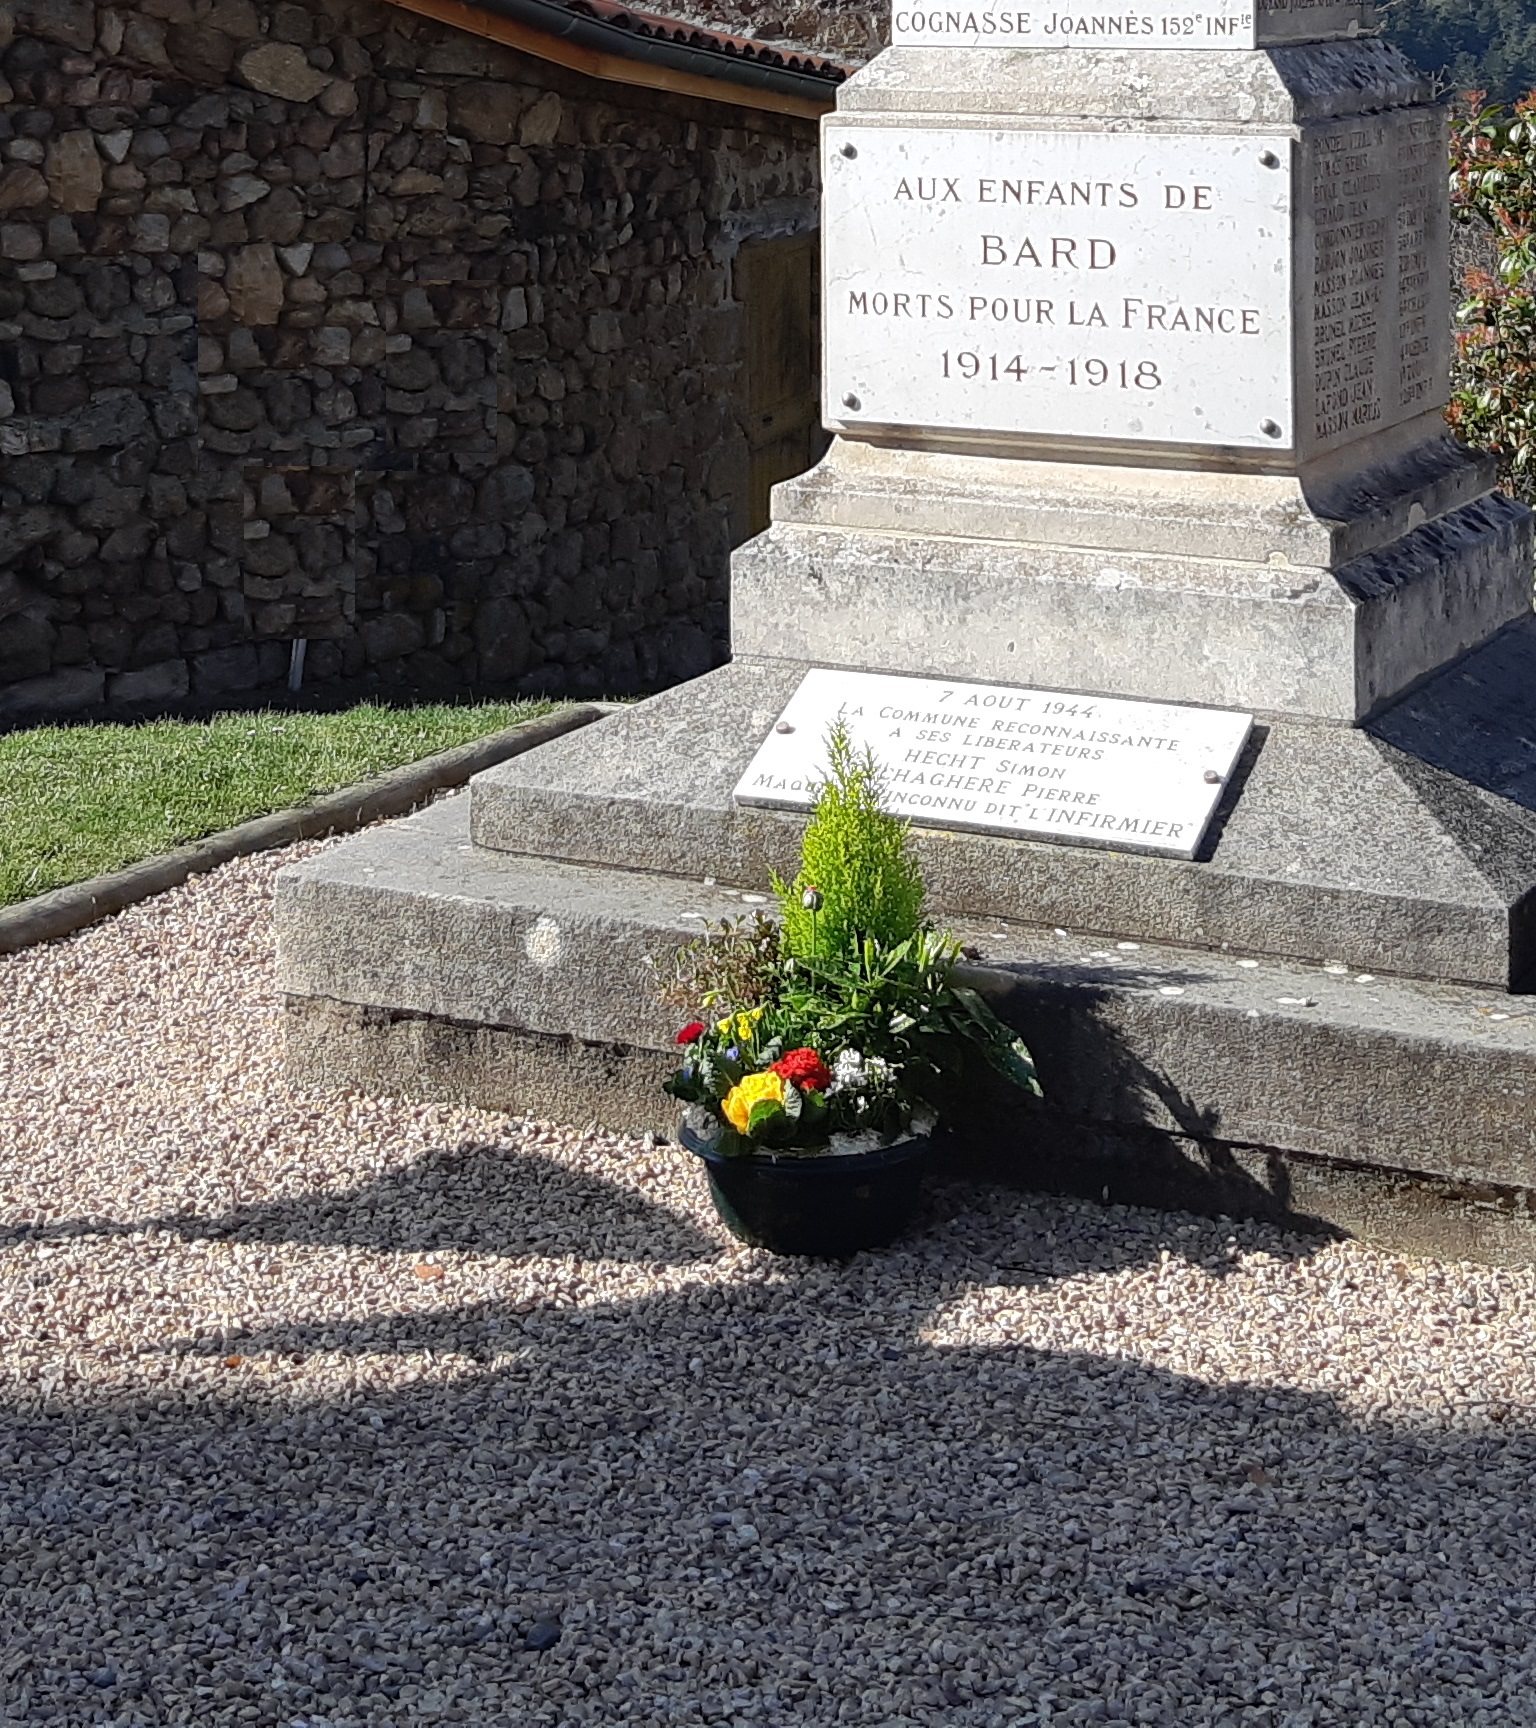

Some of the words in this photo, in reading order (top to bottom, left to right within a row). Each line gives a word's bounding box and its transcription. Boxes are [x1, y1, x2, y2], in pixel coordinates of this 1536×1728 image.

[896, 11, 1031, 34] COGNASSE
[893, 177, 962, 202] AUX
[979, 178, 1138, 208] ENFANTS
[1164, 184, 1213, 210] DE
[981, 234, 1116, 270] BARD
[848, 290, 954, 319] MORTS
[969, 296, 1056, 325] POUR
[1068, 300, 1109, 328] LA
[1121, 297, 1261, 335] FRANCE
[942, 348, 1162, 390] 1914-1918
[939, 690, 955, 703] 7
[964, 693, 1031, 711] AOUT
[1042, 701, 1098, 719] 1944
[837, 701, 864, 717] LA
[879, 705, 981, 729] COMMUNE
[991, 719, 1181, 752] RECONNAISSANTE
[889, 726, 902, 738] A
[915, 729, 952, 743] SES
[962, 734, 1105, 761] LIBERATEURS
[905, 748, 986, 770] HECHT
[996, 759, 1067, 780] SIMON
[984, 802, 1023, 818] DIT
[1021, 783, 1101, 806] PIERRE
